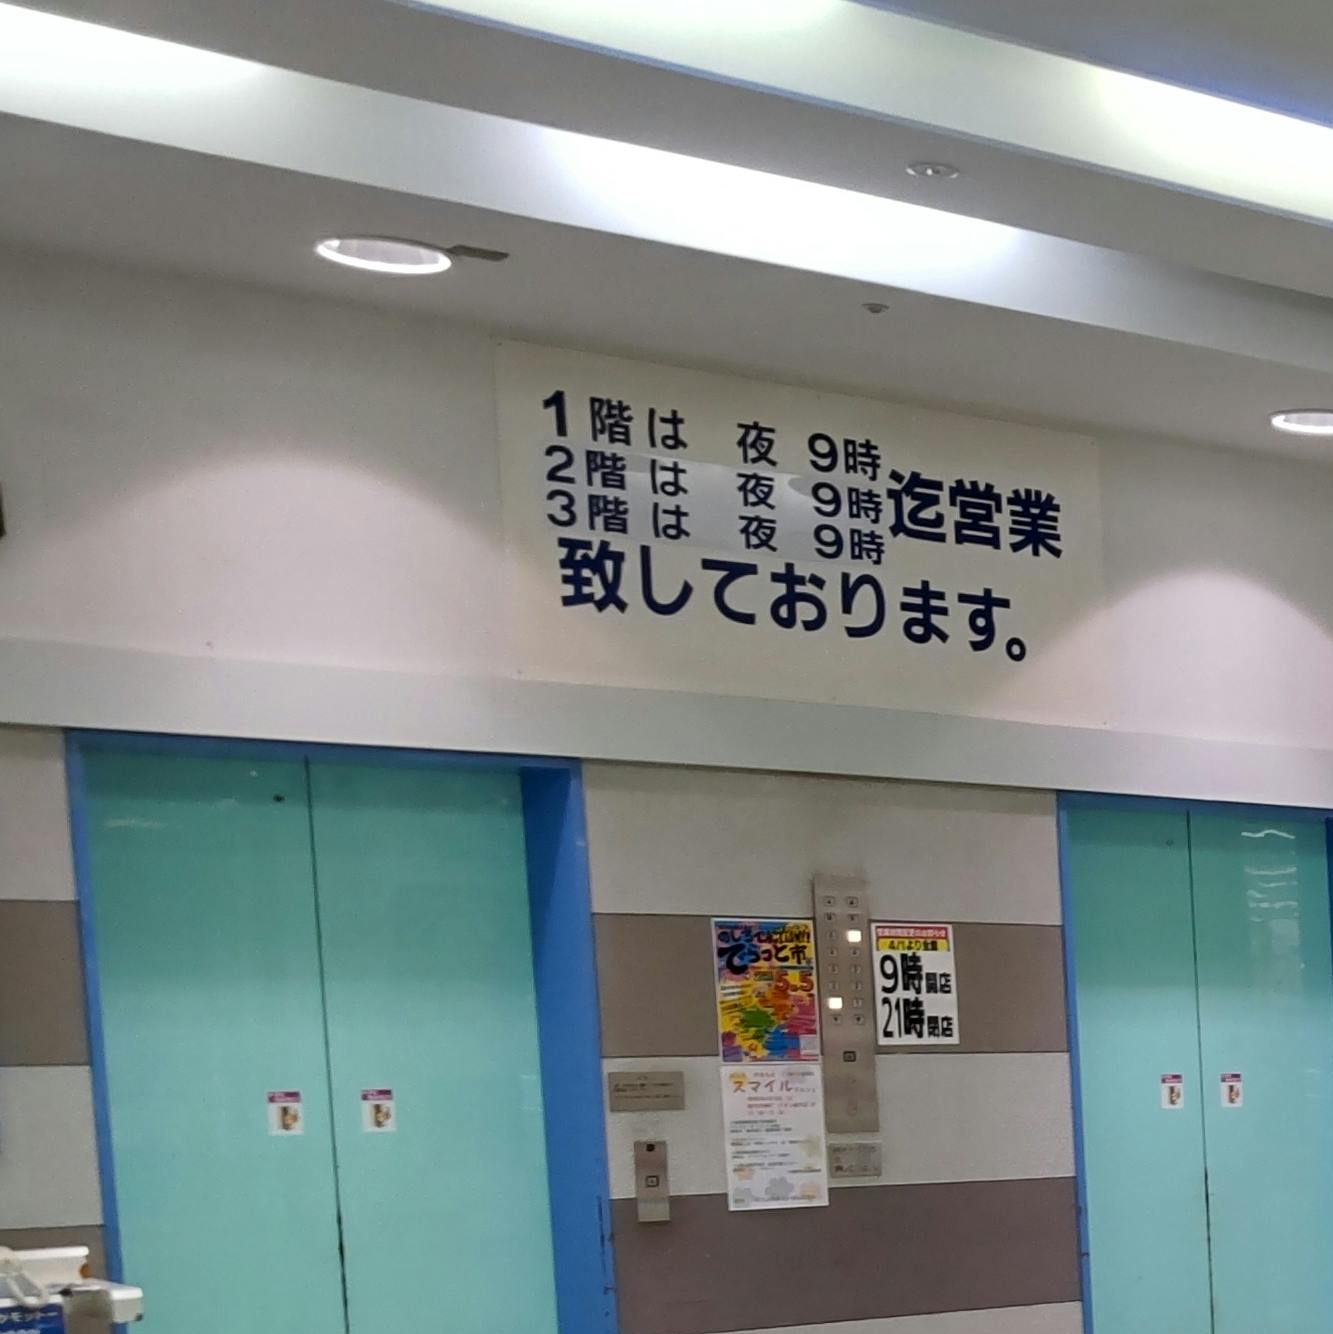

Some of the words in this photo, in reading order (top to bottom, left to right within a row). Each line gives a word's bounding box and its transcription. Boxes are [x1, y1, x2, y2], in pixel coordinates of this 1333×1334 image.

[737, 421, 778, 466] 夜
[807, 432, 881, 482] 9時
[736, 471, 778, 510] 夜
[811, 481, 883, 526] 9時
[885, 468, 1063, 559] 迄営業
[739, 514, 778, 553] 夜
[813, 523, 885, 566] 9時
[557, 537, 1027, 662] 致しております。
[880, 952, 923, 995] 9時
[925, 972, 951, 994] 開店
[882, 997, 925, 1038] 21時
[926, 1015, 953, 1037] 閉店
[733, 1080, 793, 1093] スマイル
